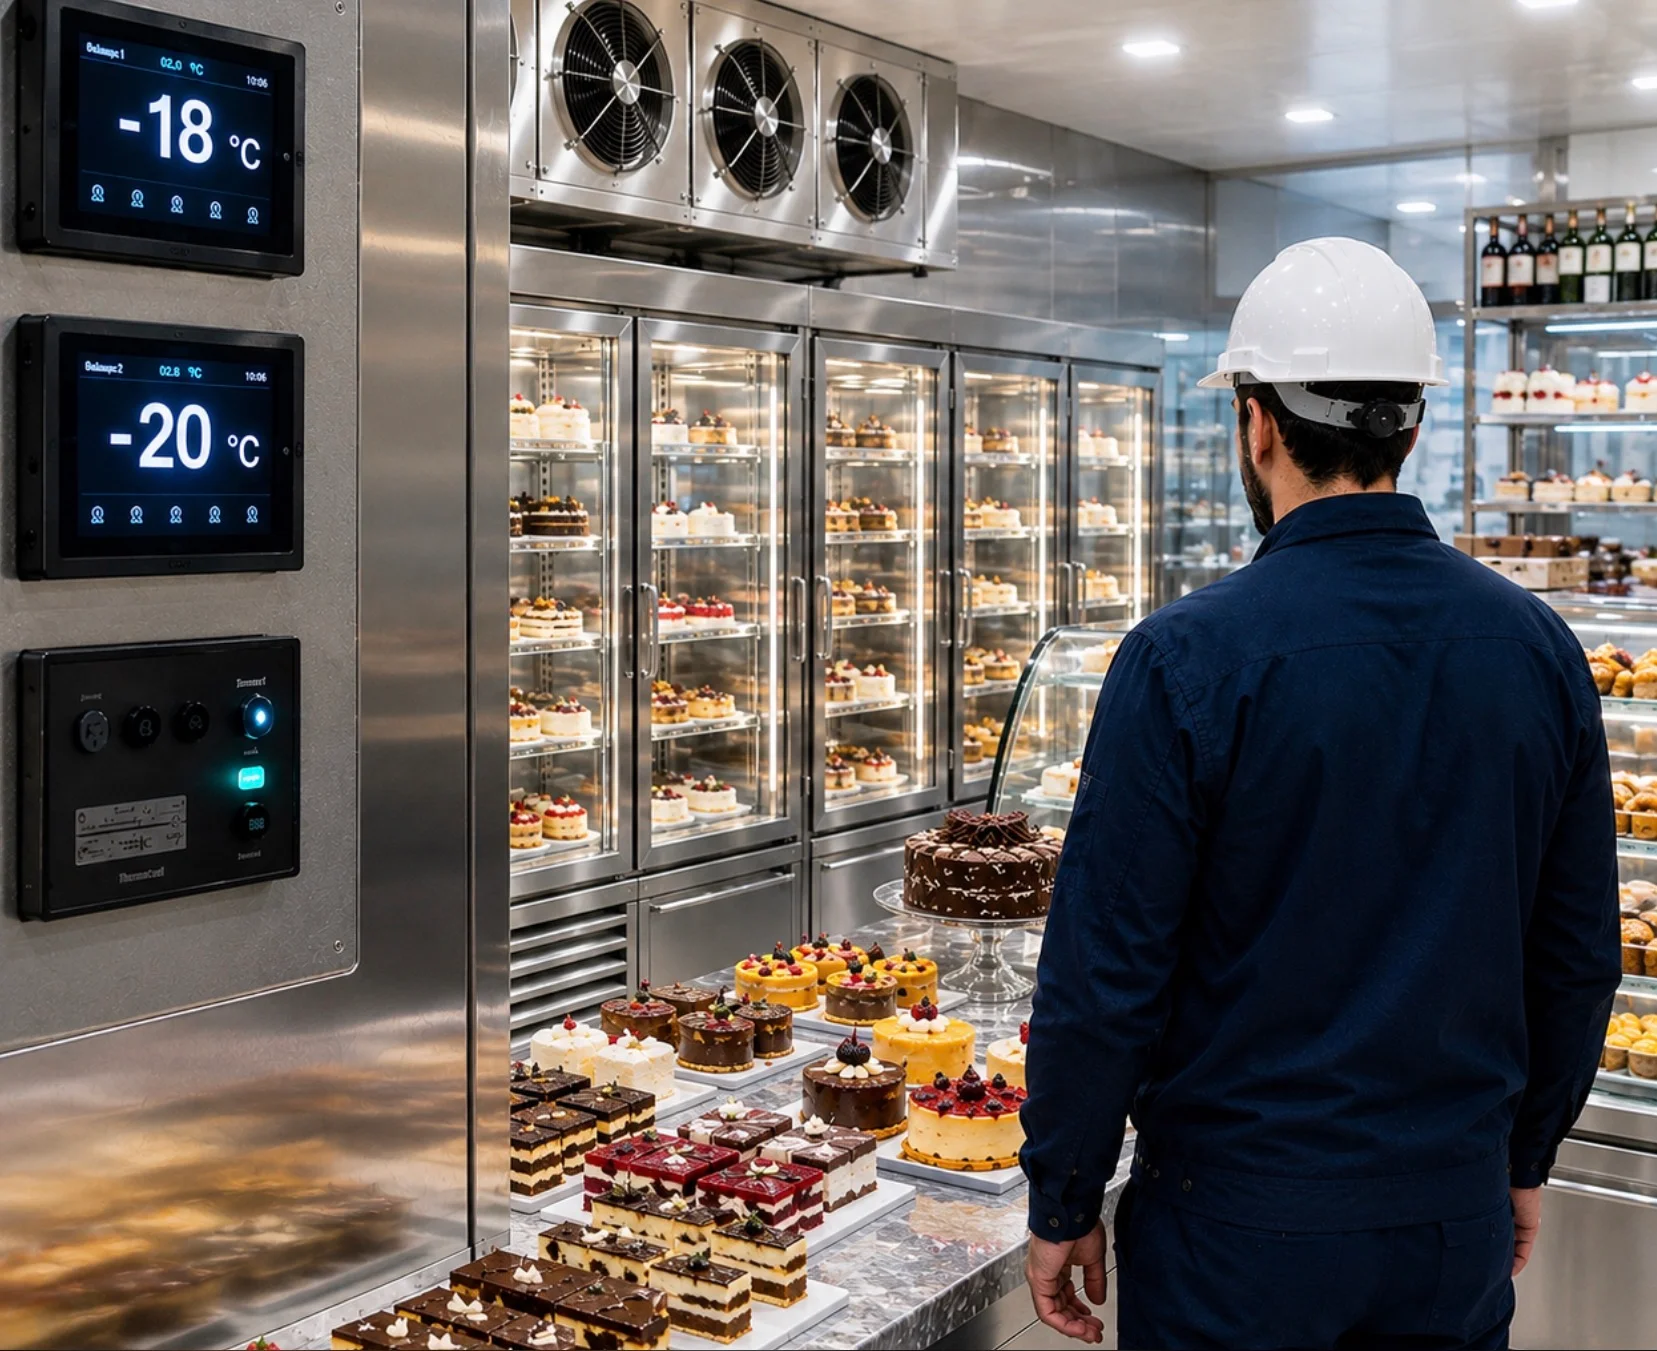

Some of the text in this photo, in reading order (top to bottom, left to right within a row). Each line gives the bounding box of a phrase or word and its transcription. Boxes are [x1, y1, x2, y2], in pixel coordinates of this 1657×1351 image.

[119, 94, 261, 170] -18 °C
[110, 402, 260, 470] -20 °C
